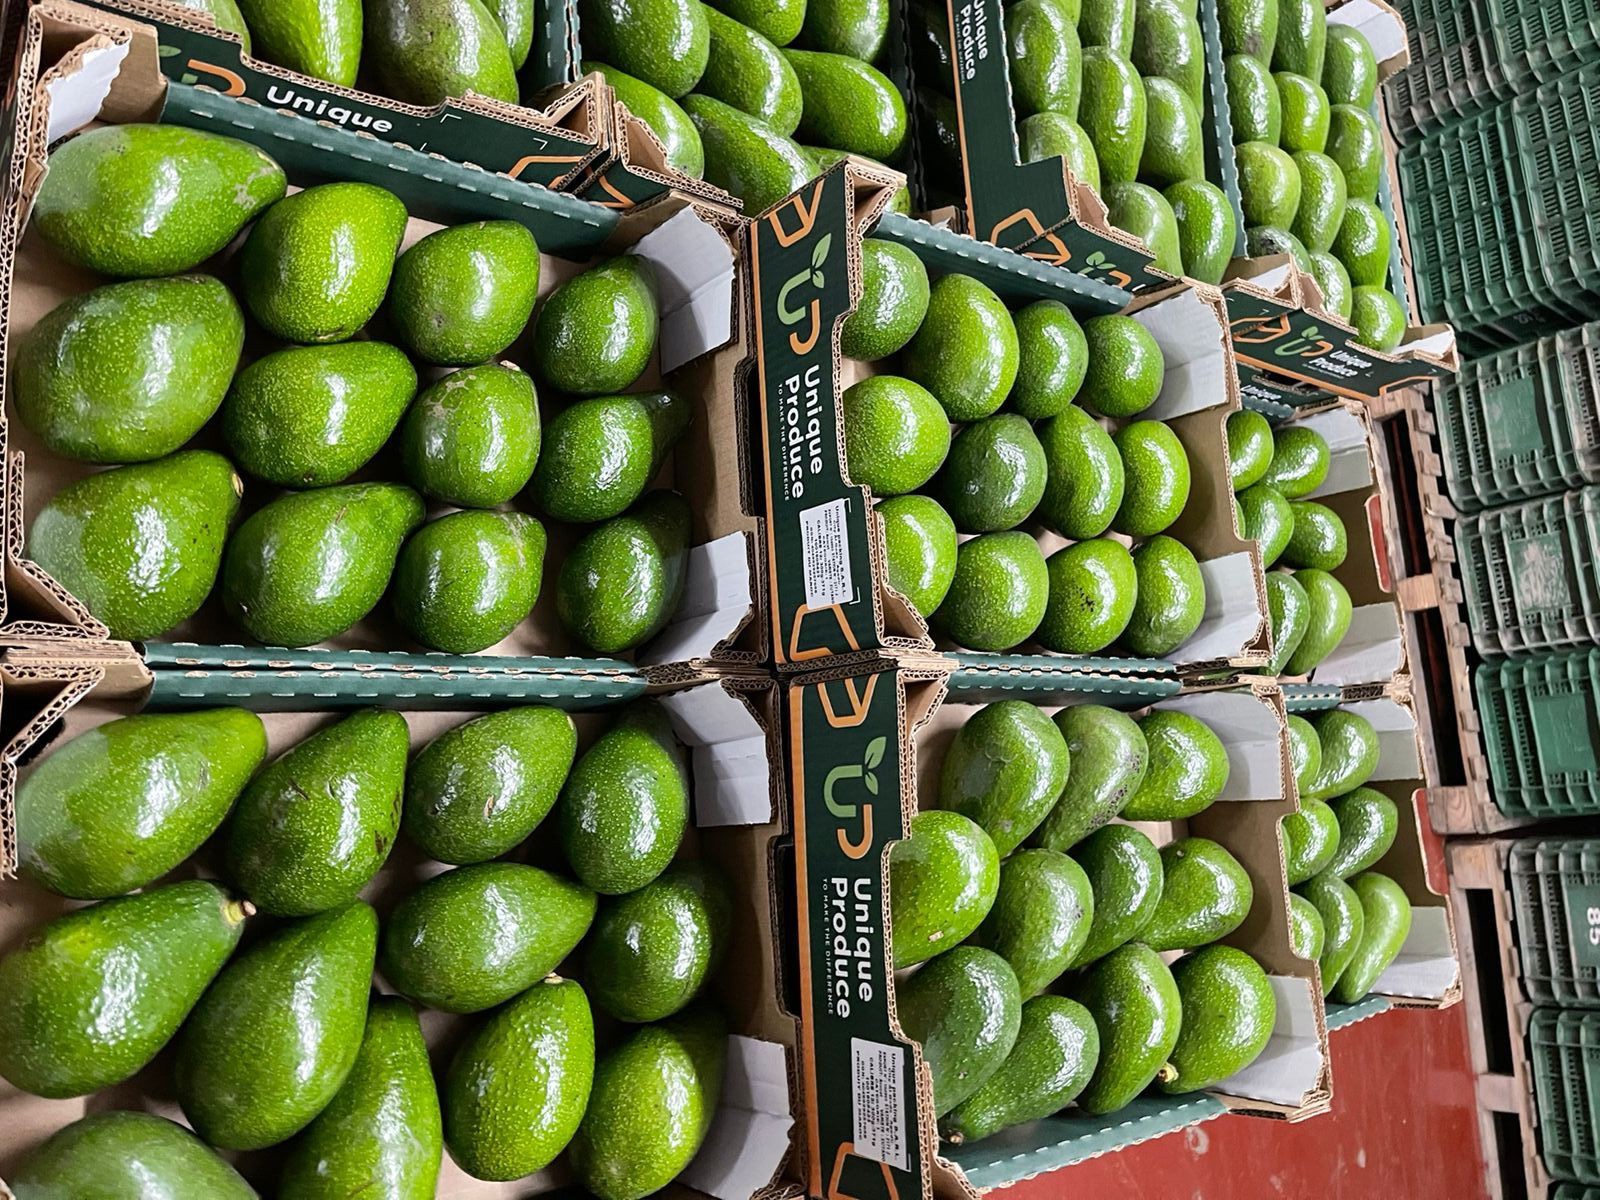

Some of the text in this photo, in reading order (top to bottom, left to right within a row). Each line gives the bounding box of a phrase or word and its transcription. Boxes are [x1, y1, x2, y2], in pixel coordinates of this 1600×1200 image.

[960, 4, 976, 80] Produce
[974, 0, 988, 60] Unique
[266, 86, 393, 133] Unique
[786, 374, 804, 499] Produce
[804, 364, 824, 474] Unique
[781, 446, 789, 502] DIFFERENCE
[831, 877, 852, 1019] Produce
[854, 878, 874, 1002] Unique
[826, 950, 834, 1015] DIFFERENCE
